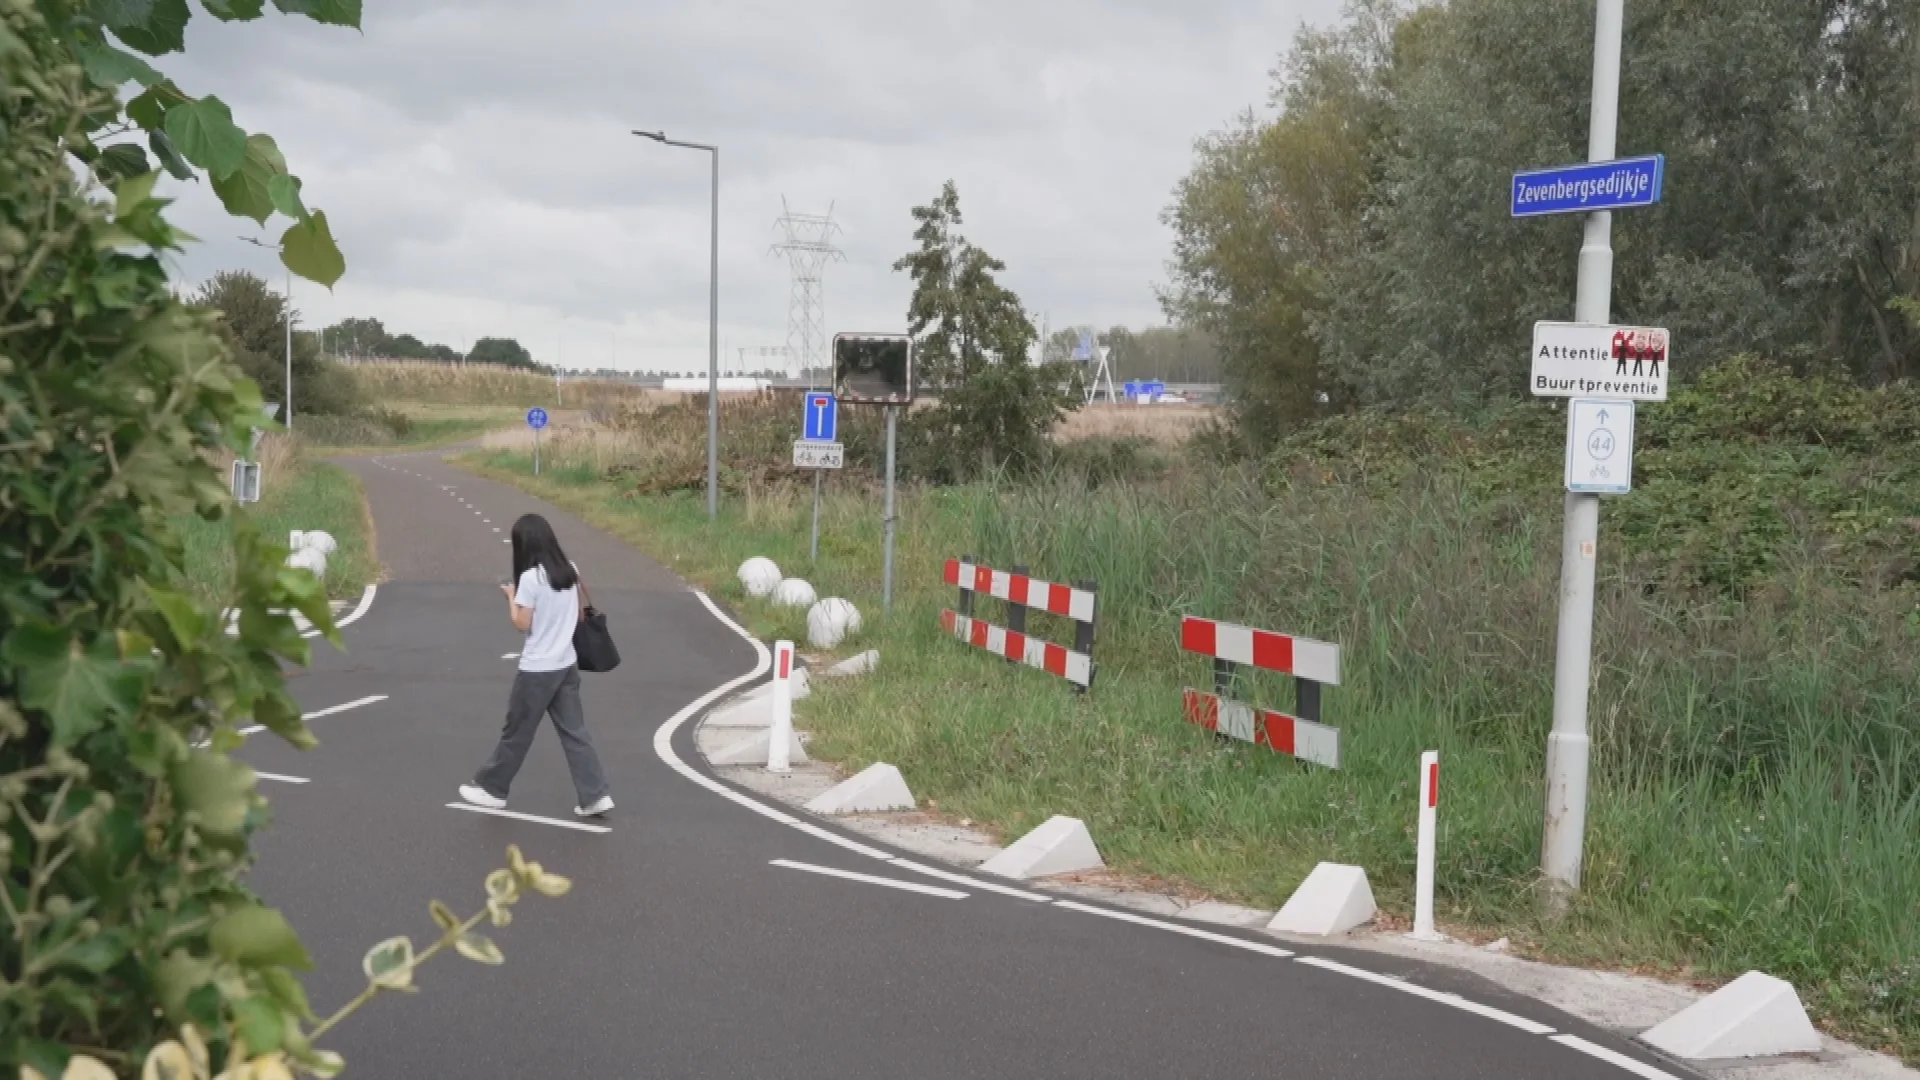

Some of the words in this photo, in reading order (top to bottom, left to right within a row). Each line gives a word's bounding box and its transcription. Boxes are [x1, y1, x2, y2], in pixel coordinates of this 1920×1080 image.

[1517, 167, 1649, 203] Zevenbergsedijkje
[1539, 345, 1609, 360] Attentie
[1536, 375, 1659, 395] Buurtpreventie
[1591, 437, 1611, 452] 44
